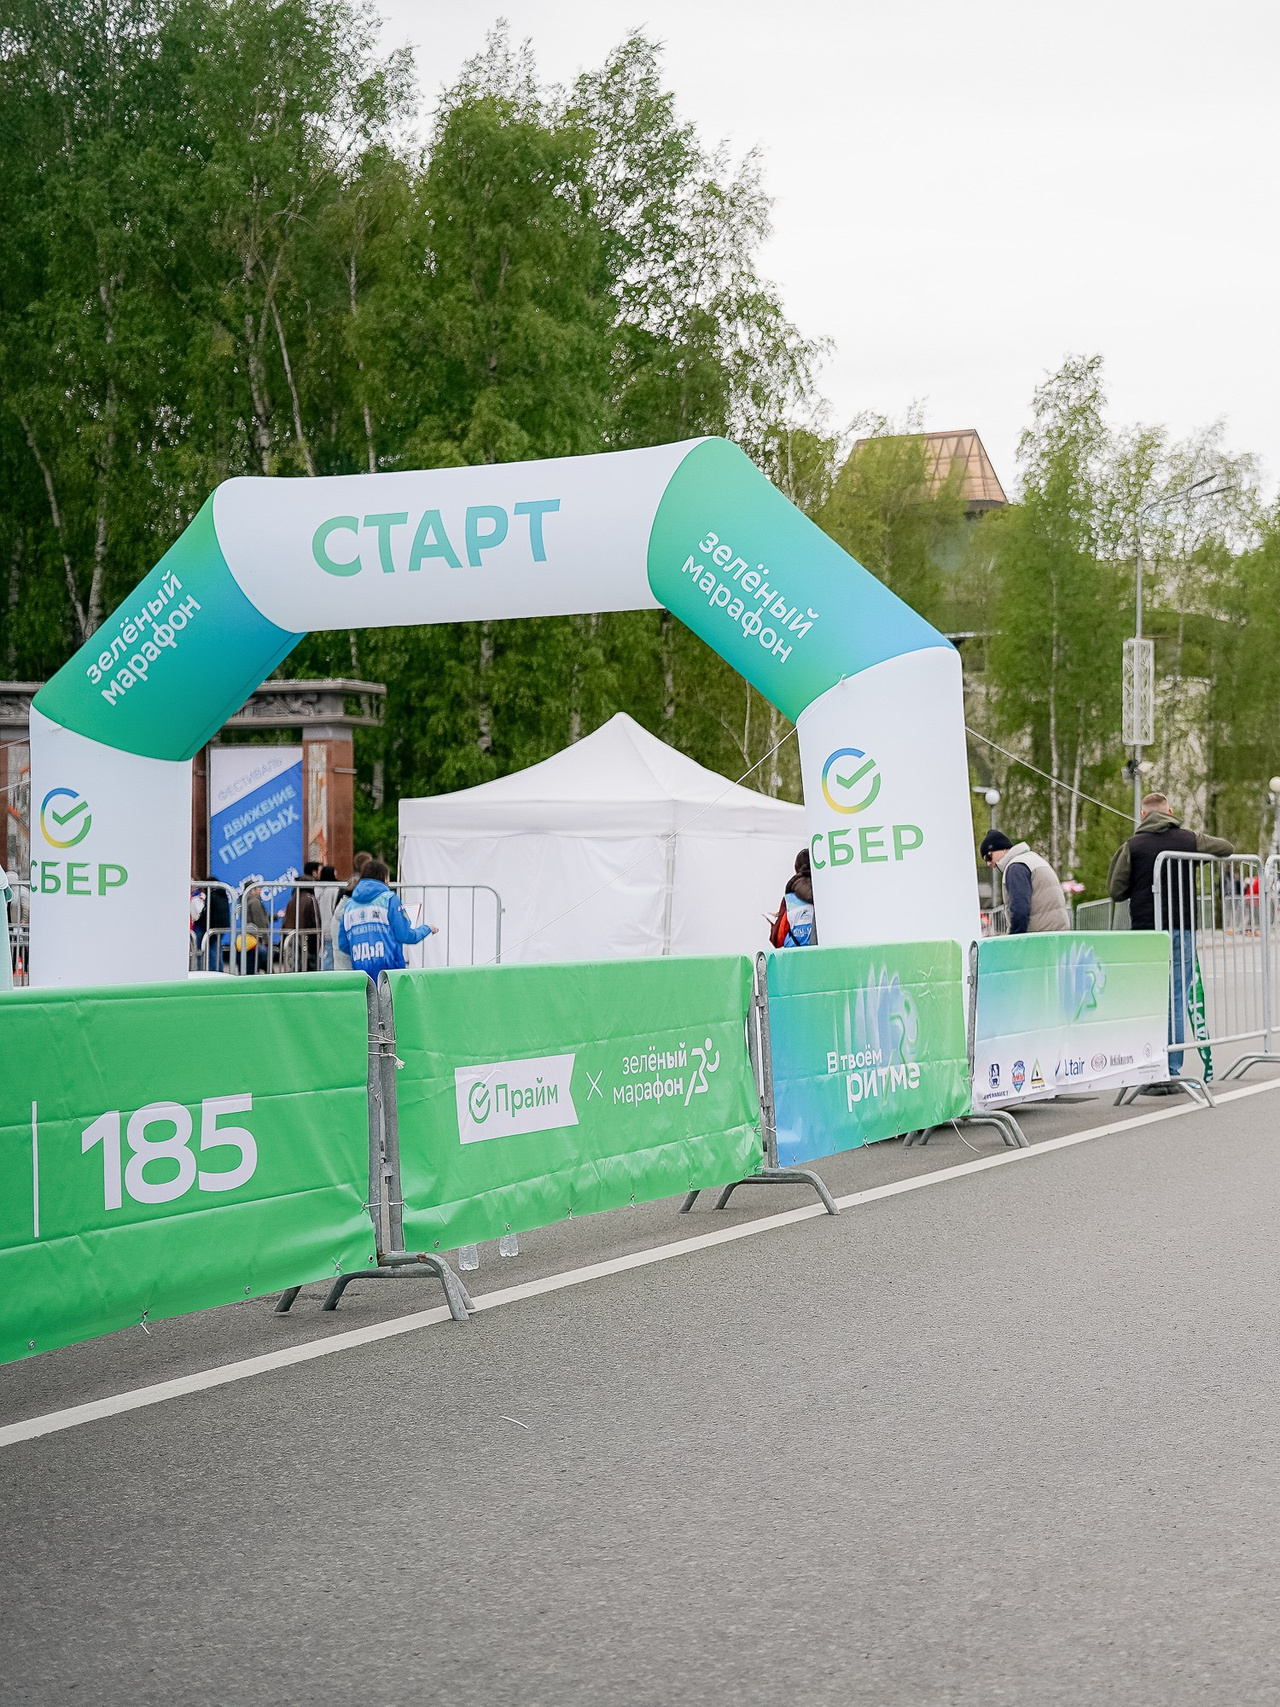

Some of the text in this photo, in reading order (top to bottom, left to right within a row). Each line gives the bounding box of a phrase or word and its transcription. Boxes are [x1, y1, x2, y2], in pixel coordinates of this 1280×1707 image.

[312, 499, 561, 577] СТАРТ
[681, 554, 793, 664] марафон
[698, 531, 820, 640] зелёный
[86, 569, 183, 685] зелёный
[100, 594, 202, 706] марафон
[217, 757, 283, 801] ФЕСТИВАЛЬ
[218, 804, 300, 865] ПЕРВЫХ
[222, 784, 298, 841] ДВИЖЕНИЕ
[811, 824, 924, 870] СБЕР
[30, 859, 129, 896] СБЕР
[622, 1041, 687, 1075] зелёный
[827, 1043, 883, 1074] В твоём
[495, 1077, 559, 1117] Прайм
[613, 1073, 683, 1107] марафон
[846, 1062, 921, 1113] ритме
[82, 1092, 258, 1211] 185
